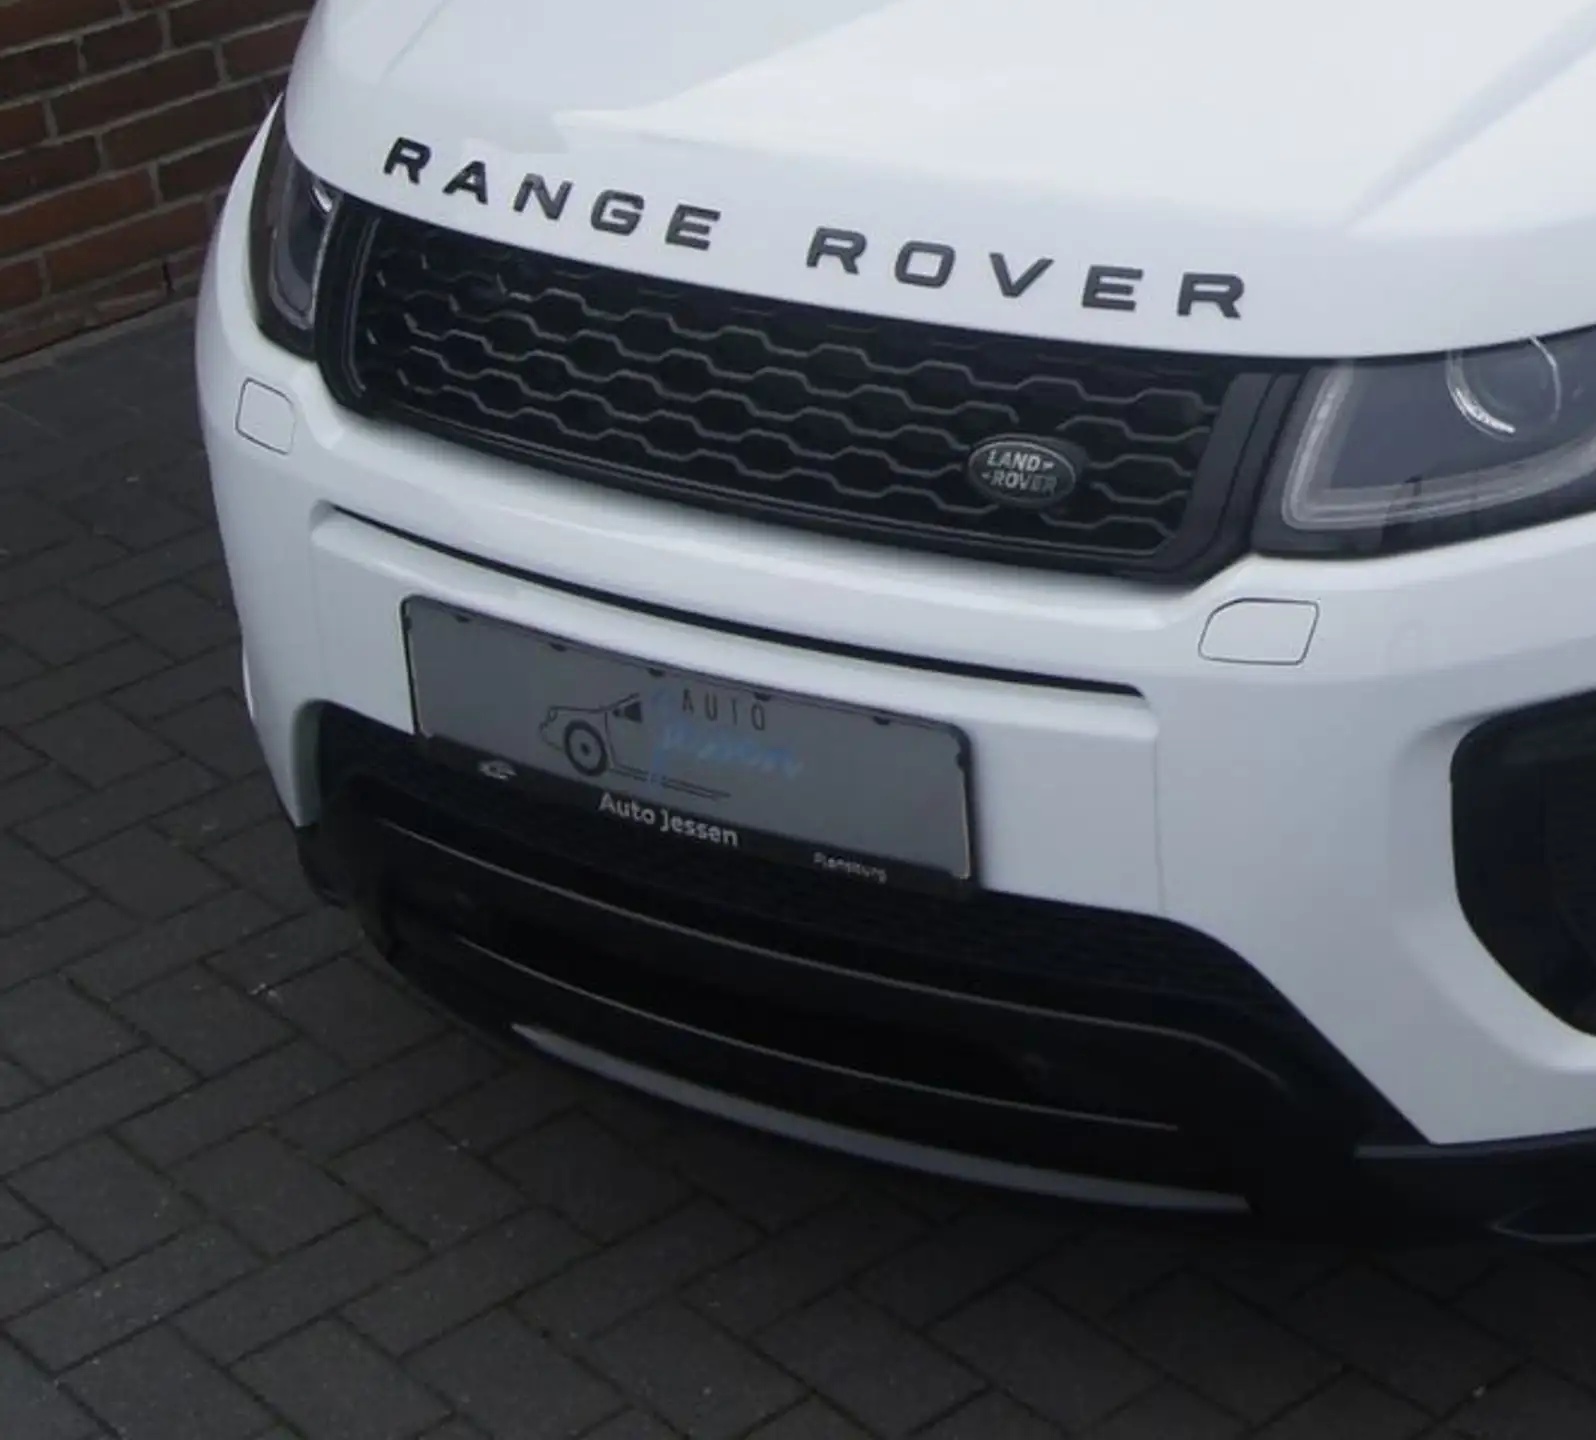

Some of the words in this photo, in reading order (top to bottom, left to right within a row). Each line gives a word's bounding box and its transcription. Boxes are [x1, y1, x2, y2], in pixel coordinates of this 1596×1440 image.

[383, 136, 722, 251] RANGE
[805, 225, 1246, 319] ROVER
[599, 791, 655, 826] Auto
[659, 808, 739, 849] Jessen
